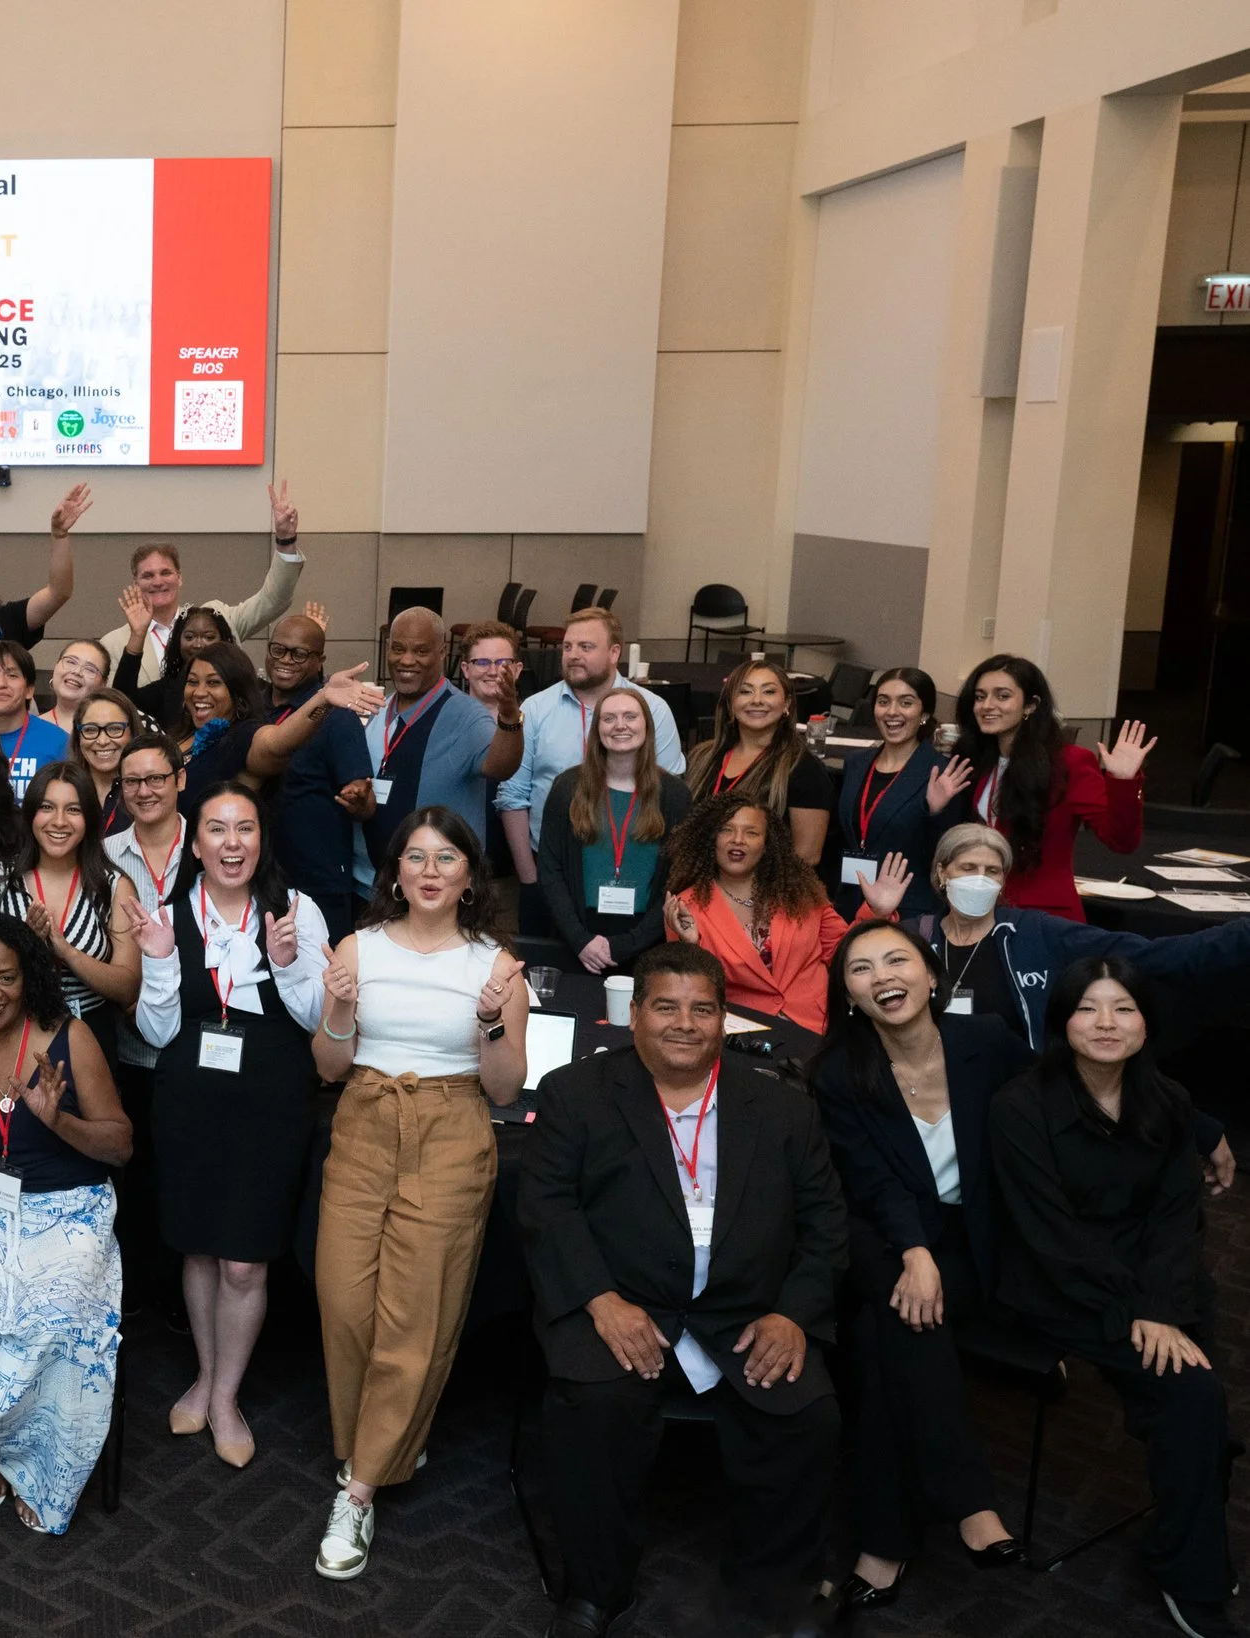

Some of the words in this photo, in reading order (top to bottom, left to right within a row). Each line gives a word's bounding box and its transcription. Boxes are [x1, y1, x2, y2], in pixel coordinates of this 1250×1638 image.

[1208, 284, 1250, 309] EXI
[178, 347, 239, 359] SPEAKER
[192, 362, 224, 375] BIOS
[6, 386, 68, 399] Chicago,
[73, 386, 121, 398] Illinois
[91, 411, 136, 428] Joyce
[55, 443, 103, 454] GIFFORDS
